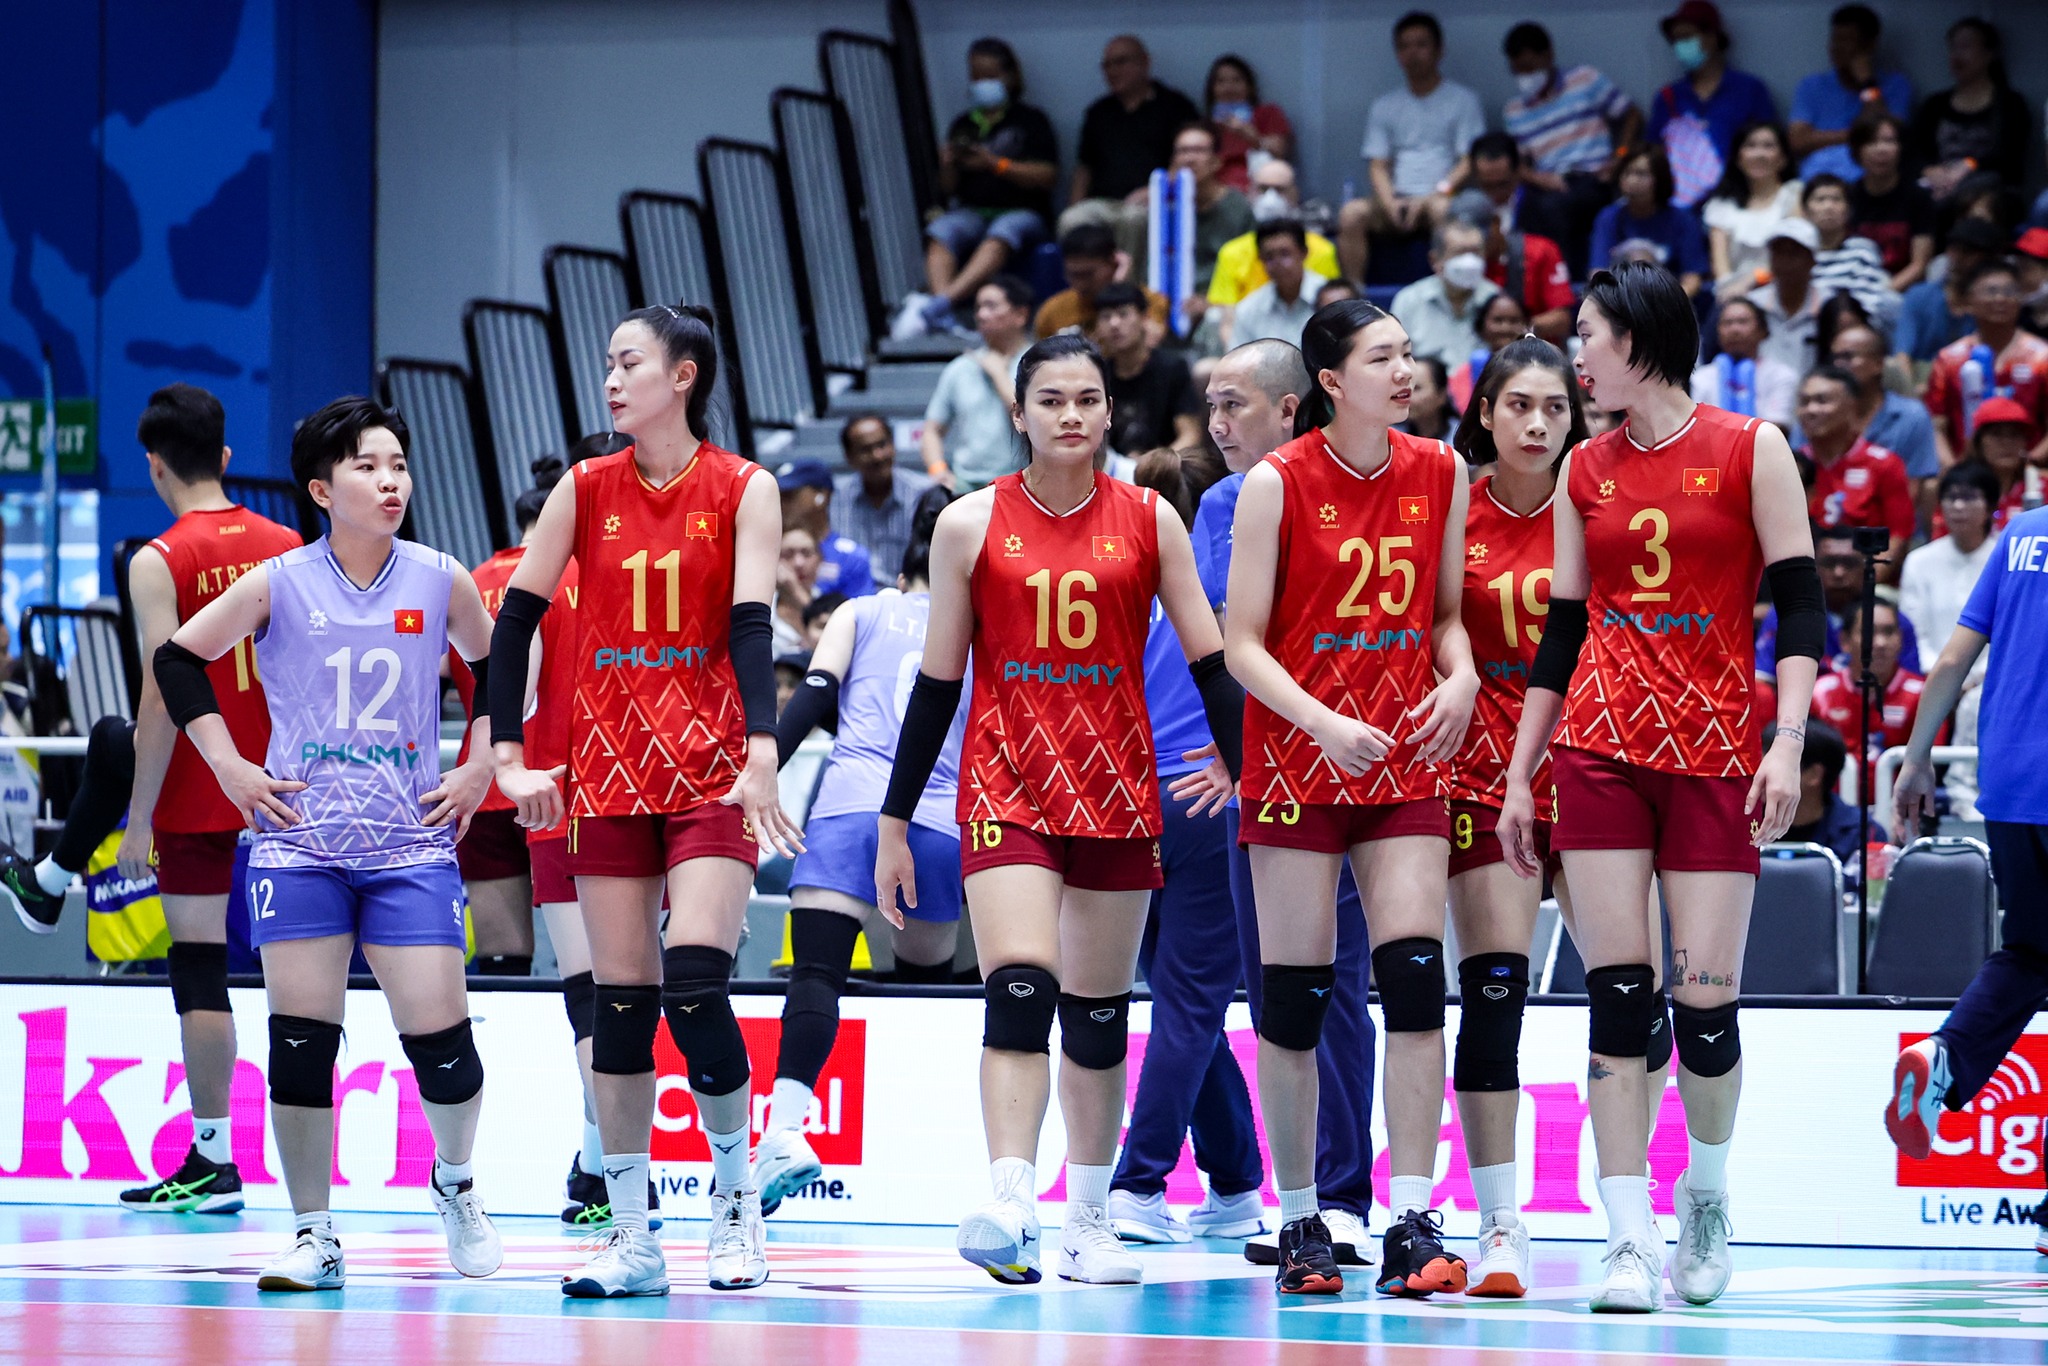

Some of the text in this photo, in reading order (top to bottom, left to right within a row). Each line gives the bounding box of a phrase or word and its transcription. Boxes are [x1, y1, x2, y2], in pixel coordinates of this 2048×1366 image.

[1628, 508, 1671, 589] 3
[2008, 536, 2048, 573] VIE
[621, 550, 681, 632] 11
[1336, 536, 1416, 618] 25
[1025, 568, 1098, 649] 16
[1487, 568, 1554, 648] 19
[1313, 622, 1425, 654] PHUMY
[595, 646, 709, 671] PHUMY
[1003, 658, 1124, 686] PHUMY
[325, 647, 402, 732] 12
[302, 742, 419, 770] PHUMY
[970, 820, 1002, 851] 16
[251, 878, 276, 921] 12
[1921, 1194, 1983, 1224] Live
